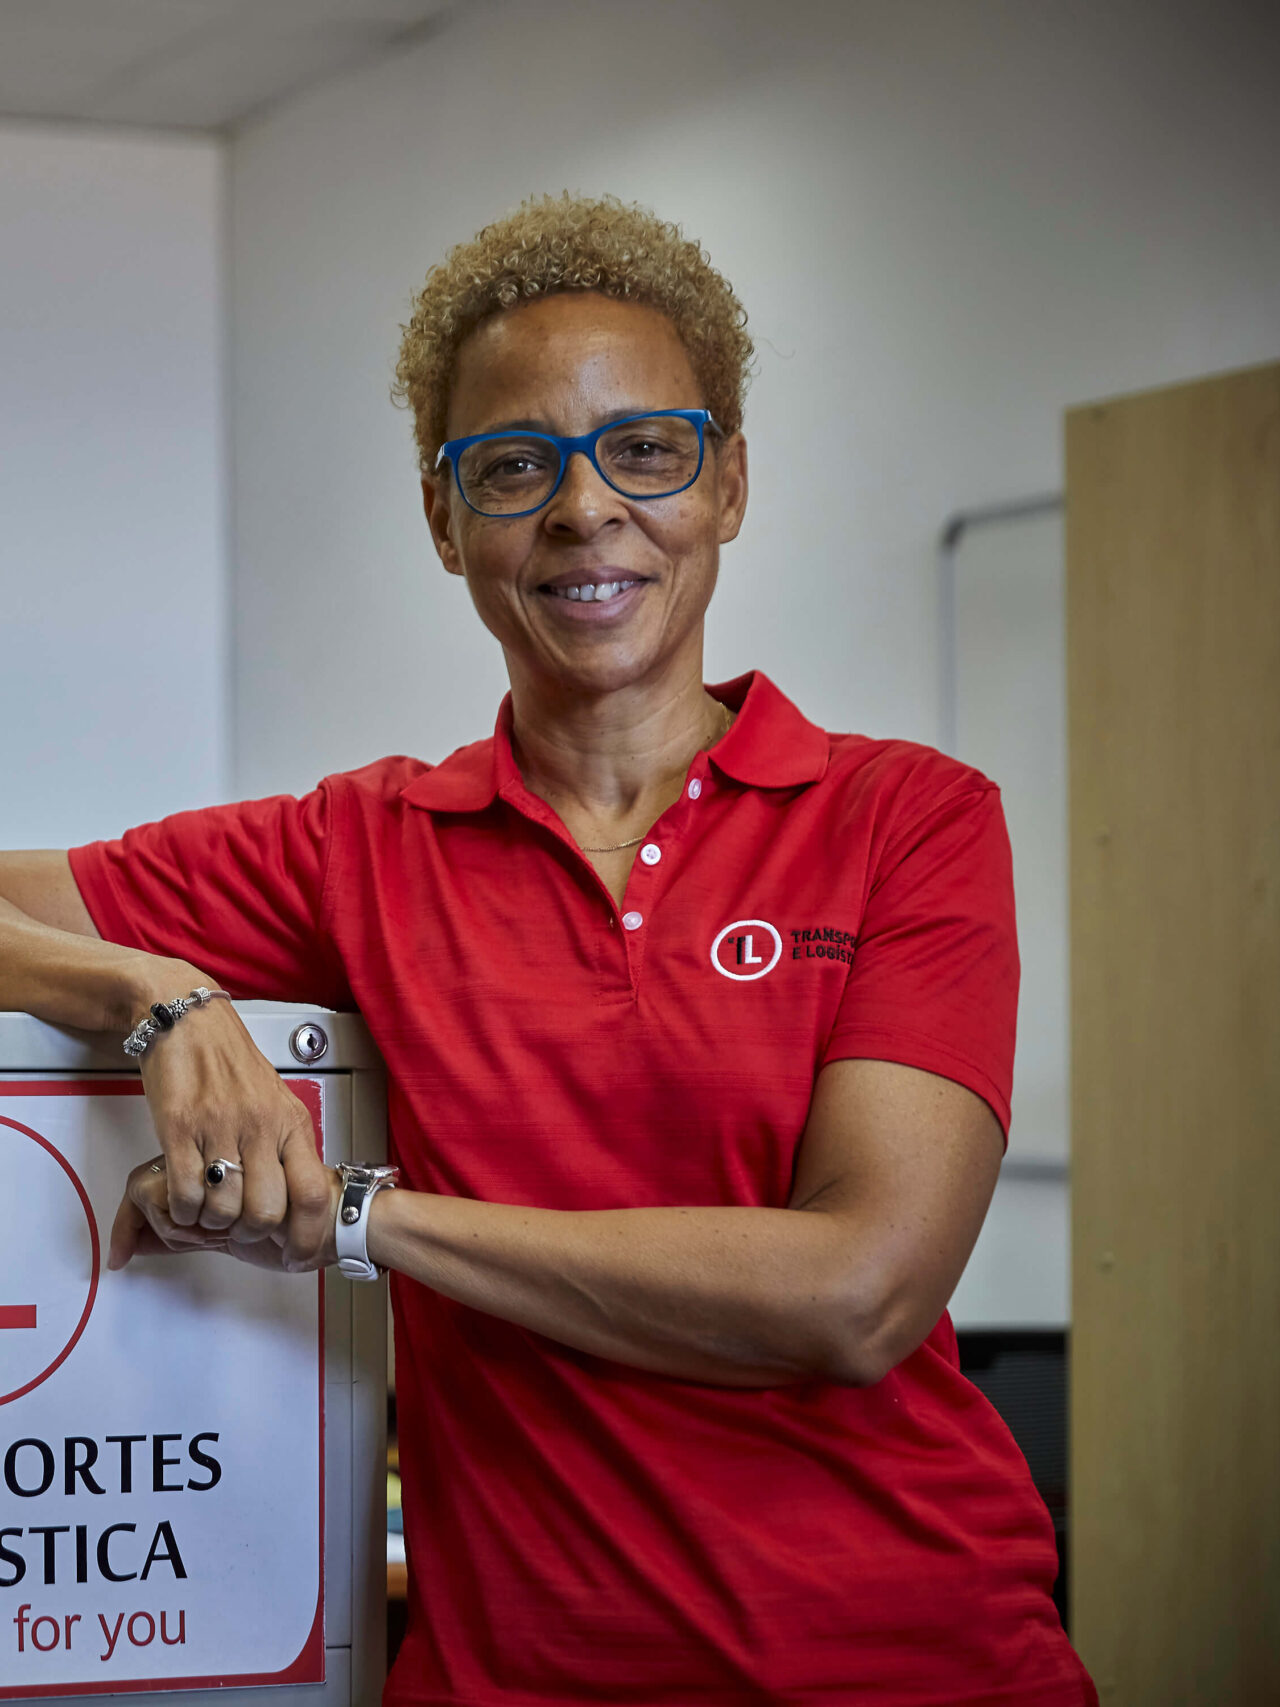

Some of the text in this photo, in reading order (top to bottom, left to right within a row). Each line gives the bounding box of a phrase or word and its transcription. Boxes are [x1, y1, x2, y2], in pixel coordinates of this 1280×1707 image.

[790, 927, 857, 948] TRANSPO
[792, 946, 802, 961] E
[13, 1603, 82, 1653] for
[97, 1609, 187, 1662] you
